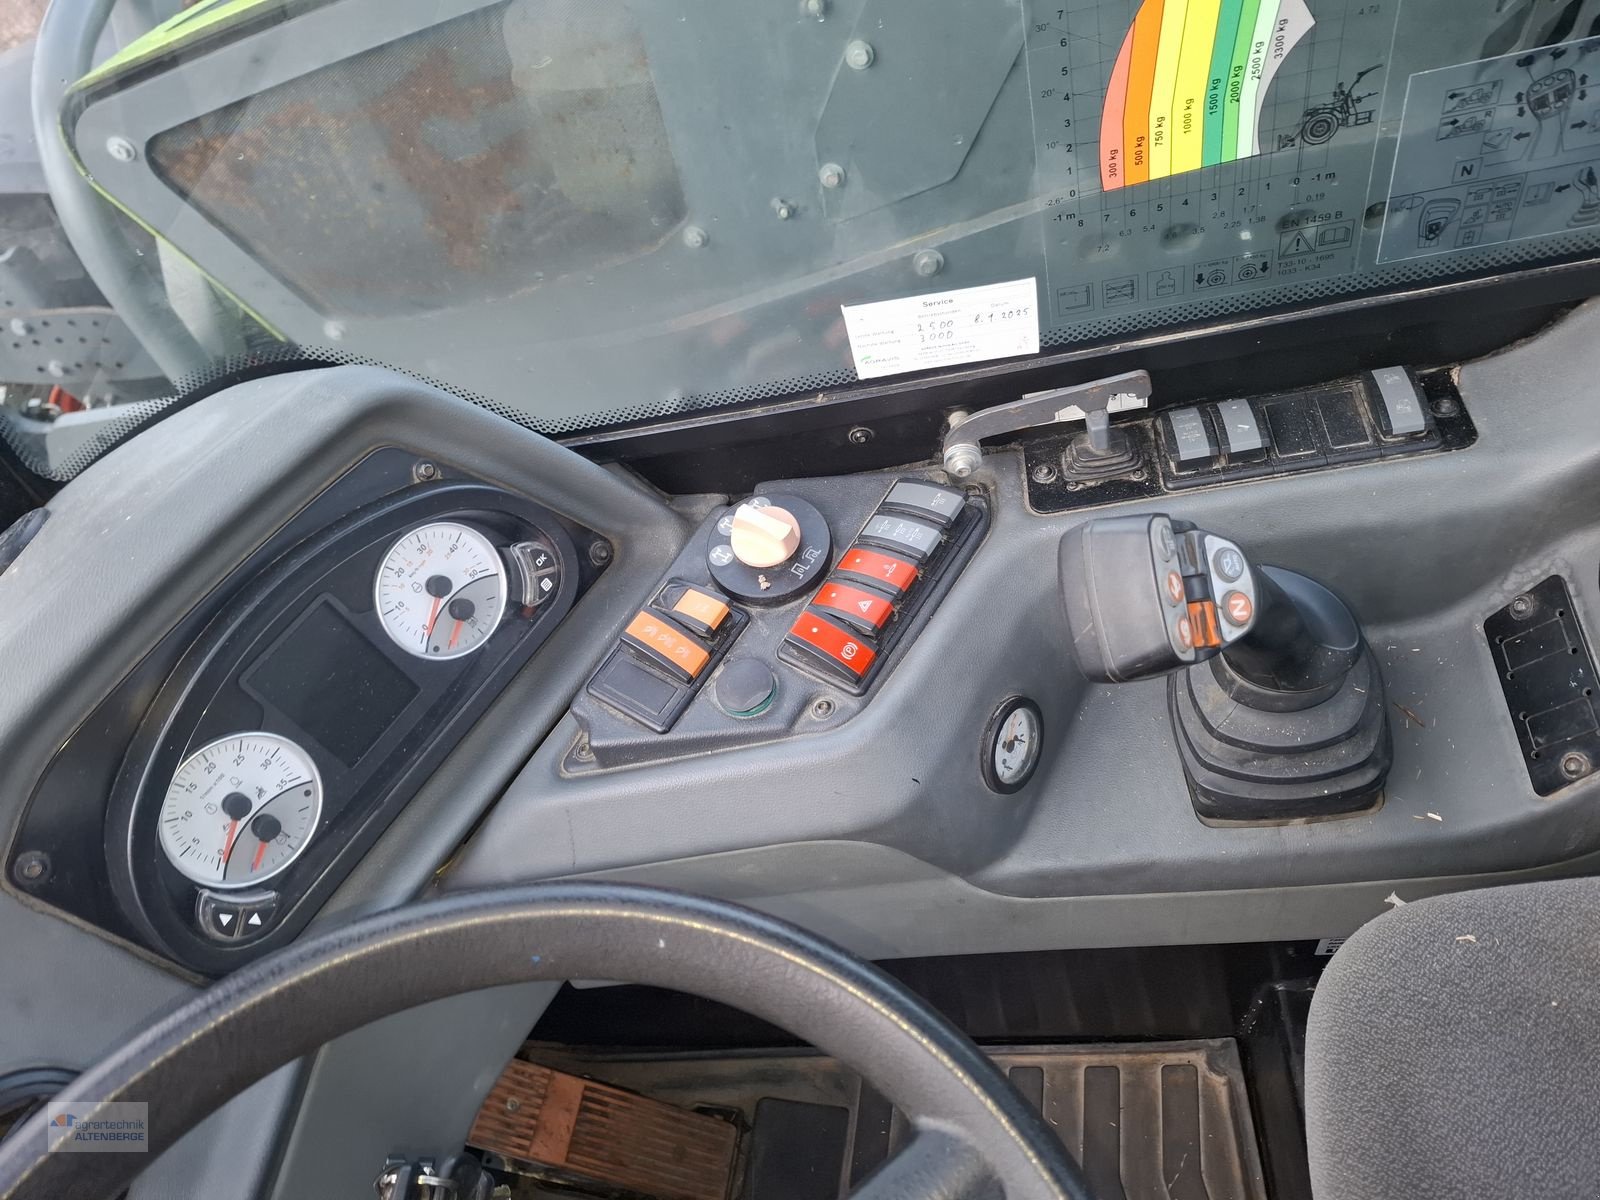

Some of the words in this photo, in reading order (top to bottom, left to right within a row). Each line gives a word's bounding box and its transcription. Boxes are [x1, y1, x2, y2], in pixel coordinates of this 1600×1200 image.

[1057, 10, 1064, 20] 7
[1277, 18, 1288, 33] kg
[1060, 38, 1067, 47] 6
[1253, 41, 1264, 54] kg
[1274, 35, 1285, 59] 3300
[1061, 66, 1068, 76] 5
[1232, 65, 1243, 78] kg
[1251, 57, 1261, 80] 2500
[1210, 78, 1221, 91] kg
[1063, 92, 1070, 101] 4
[1230, 81, 1240, 103] 2000
[1184, 98, 1194, 110] kg
[1209, 93, 1218, 115] 1500
[1064, 119, 1071, 128] 3
[1155, 116, 1165, 128] kg
[1183, 113, 1192, 134] 1000
[1135, 136, 1145, 148] kg
[1155, 130, 1163, 147] 750
[1066, 143, 1073, 153] 2
[1109, 149, 1118, 160] kg
[1135, 150, 1143, 166] 500
[1067, 167, 1072, 175] 1
[1109, 162, 1117, 178] 300
[1461, 164, 1474, 177] N
[1069, 189, 1075, 198] 0
[1078, 219, 1084, 227] 8
[1104, 214, 1110, 222] 7
[1130, 208, 1136, 217] 6
[1157, 203, 1163, 212] 5
[1182, 198, 1188, 206] 4
[1211, 193, 1217, 201] 3
[1238, 188, 1245, 196] 2
[1266, 182, 1271, 190] 1
[1293, 177, 1300, 185] 0
[1066, 212, 1076, 220] m
[1282, 219, 1299, 229] EN
[1305, 212, 1331, 225] 1459
[1334, 210, 1343, 219] B
[1143, 224, 1155, 233] 5.4
[922, 298, 954, 308] Service
[416, 544, 427, 554] 30
[449, 543, 458, 554] 40
[535, 553, 547, 567] OK
[394, 567, 405, 578] 20
[469, 569, 479, 579] 50
[395, 601, 405, 611] 10
[232, 754, 245, 767] 25
[260, 758, 272, 770] 30
[204, 761, 217, 775] 20
[185, 782, 198, 794] 15
[276, 778, 288, 790] 35
[181, 810, 193, 821] 10
[191, 836, 201, 845] 5
[217, 848, 224, 856] 0
